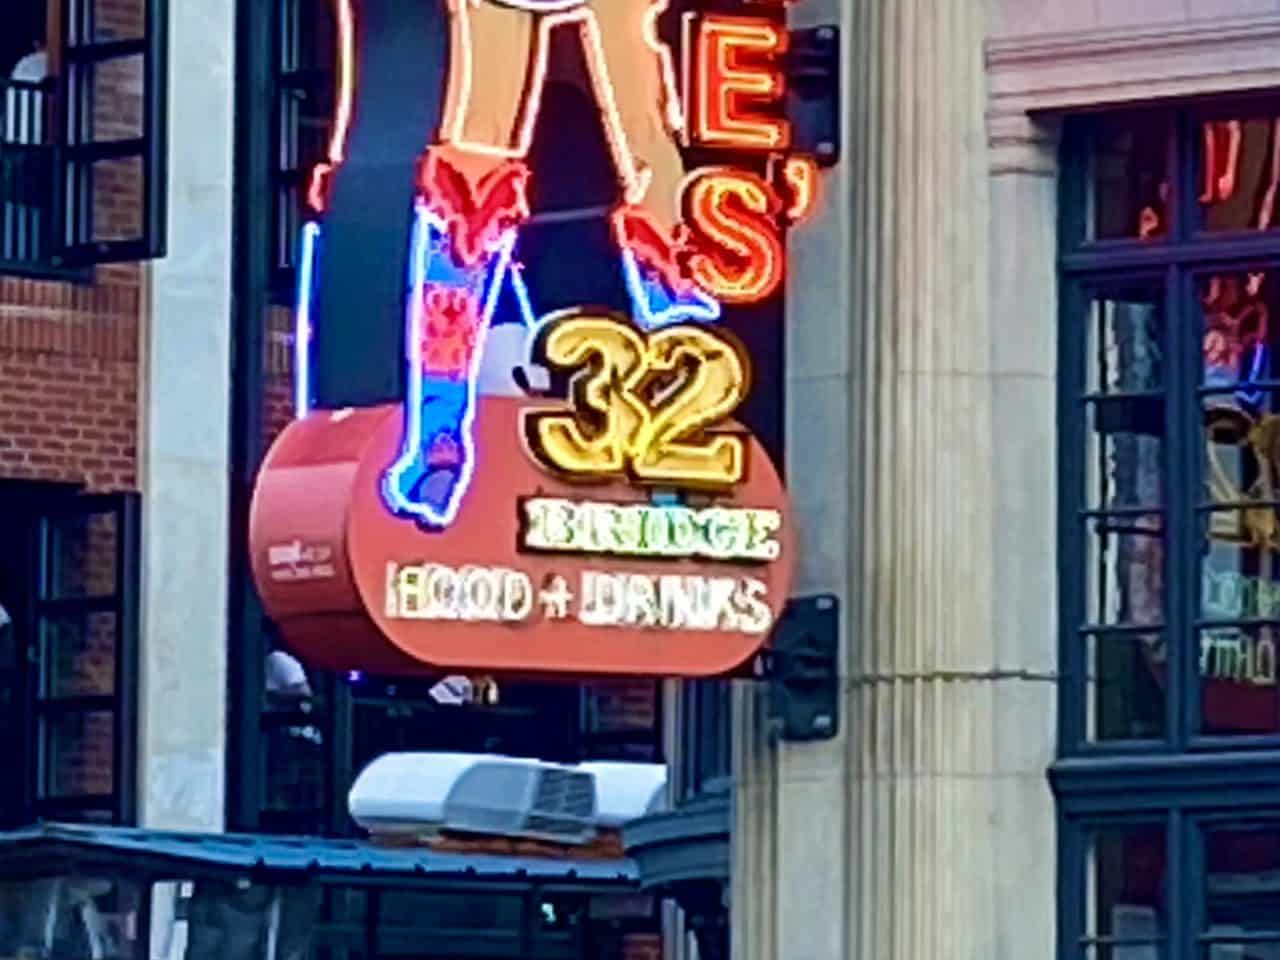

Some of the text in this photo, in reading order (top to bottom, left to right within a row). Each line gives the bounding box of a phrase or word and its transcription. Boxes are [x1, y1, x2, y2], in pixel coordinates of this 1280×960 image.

[526, 312, 748, 486] 32
[522, 497, 781, 561] BRIDGE
[385, 561, 533, 621] FOOD
[578, 570, 774, 635] DRINKS
